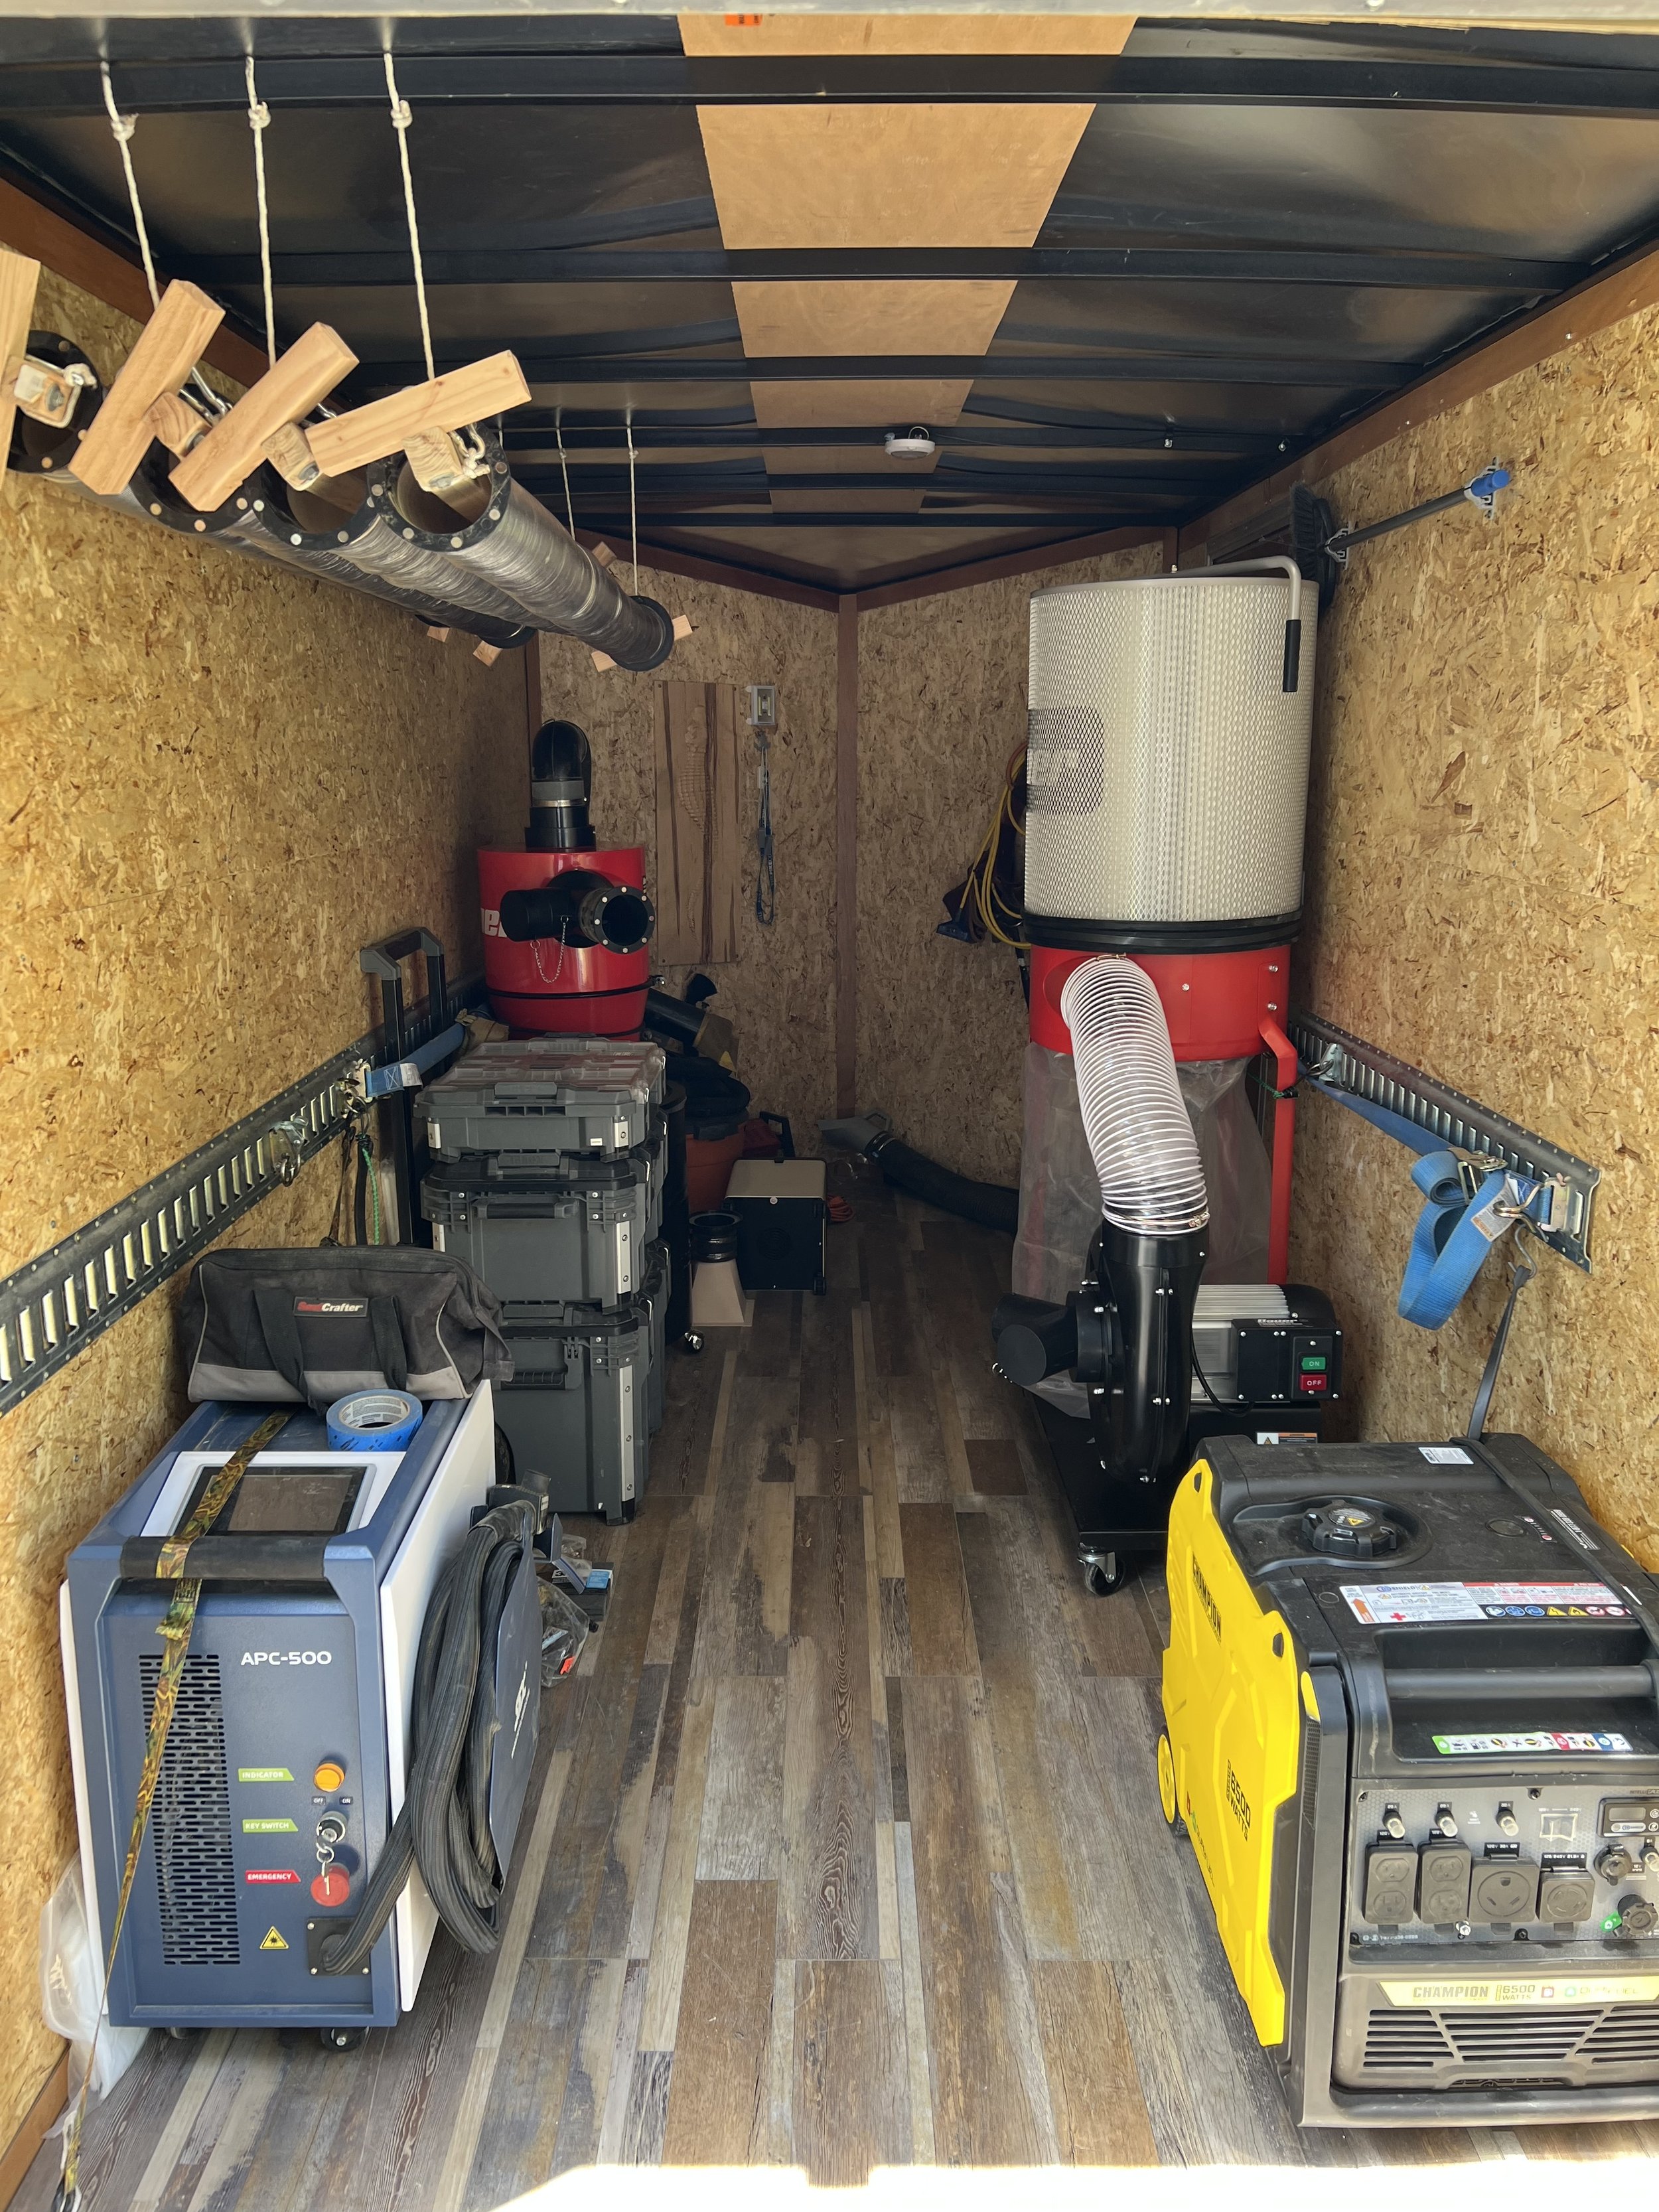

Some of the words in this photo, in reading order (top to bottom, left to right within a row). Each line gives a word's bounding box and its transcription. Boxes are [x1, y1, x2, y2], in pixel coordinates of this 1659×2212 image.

[1192, 1552, 1221, 1639] CHAMPION
[241, 1651, 332, 1666] APC-500
[1230, 1769, 1251, 1829] 6500
[1230, 1791, 1248, 1842] WATTS
[1413, 1986, 1489, 1998] CHAMPION
[1502, 1985, 1536, 1994] 6500
